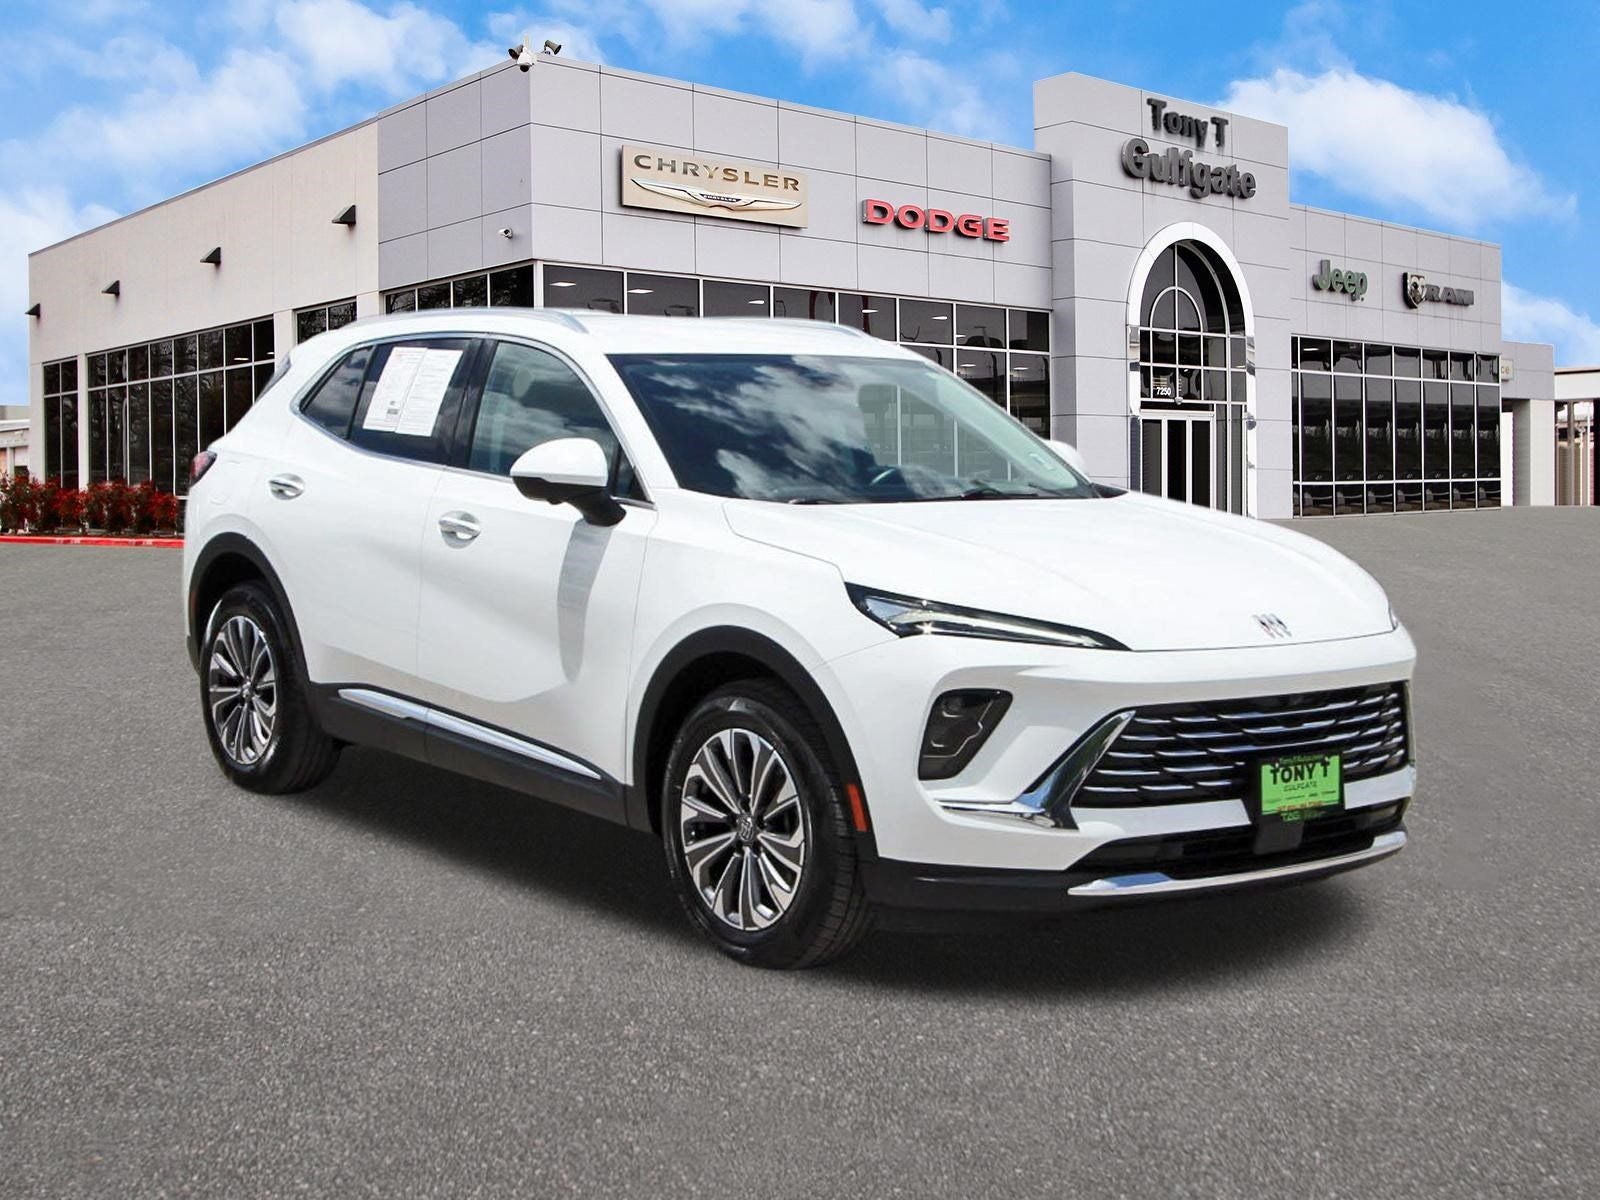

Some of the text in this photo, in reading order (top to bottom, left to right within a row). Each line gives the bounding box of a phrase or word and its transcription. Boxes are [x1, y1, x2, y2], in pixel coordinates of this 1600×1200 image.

[1146, 98, 1229, 147] Tony T
[633, 154, 800, 192] CHRYSLER
[1121, 138, 1256, 199] Gulfgate
[862, 198, 1010, 242] DODGE
[1312, 259, 1368, 302] Jeep
[1424, 284, 1475, 306] RAM
[1270, 760, 1331, 785] TONY T
